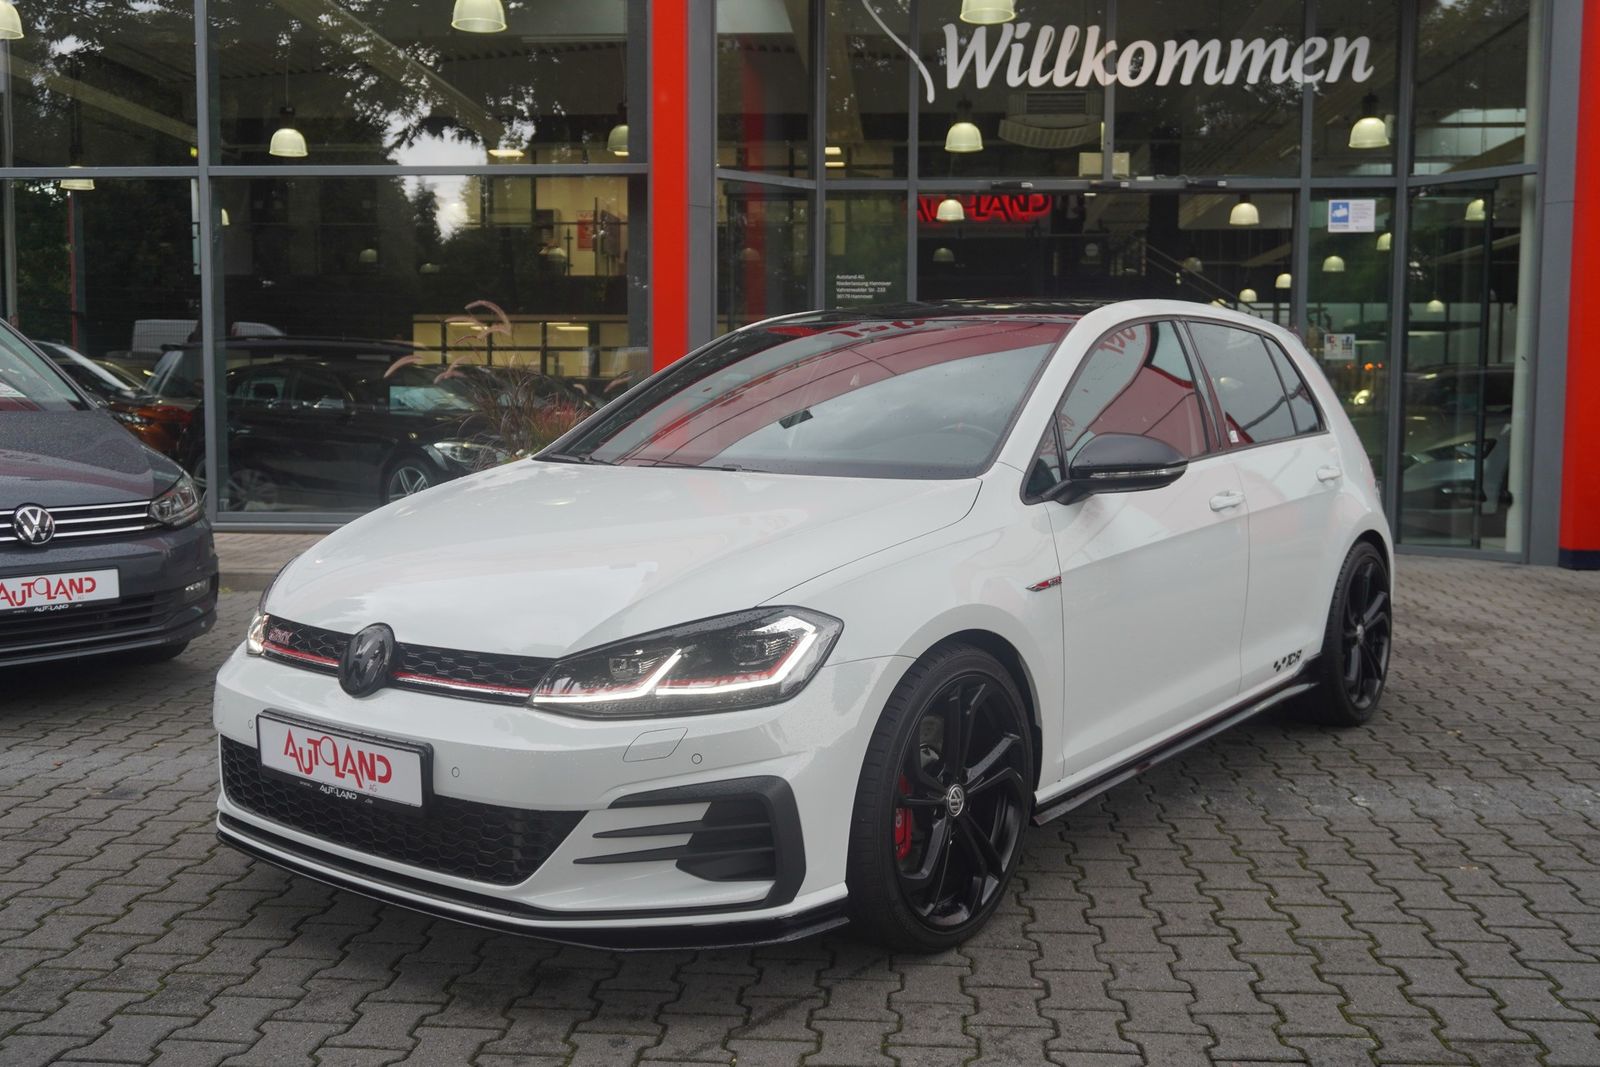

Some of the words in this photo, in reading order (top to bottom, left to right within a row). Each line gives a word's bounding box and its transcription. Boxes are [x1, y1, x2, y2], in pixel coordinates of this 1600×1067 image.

[942, 22, 1374, 89] Willkommen
[916, 193, 1051, 222] ALAND
[34, 603, 70, 613] AUTLAND
[284, 728, 393, 789] AUTOLAND
